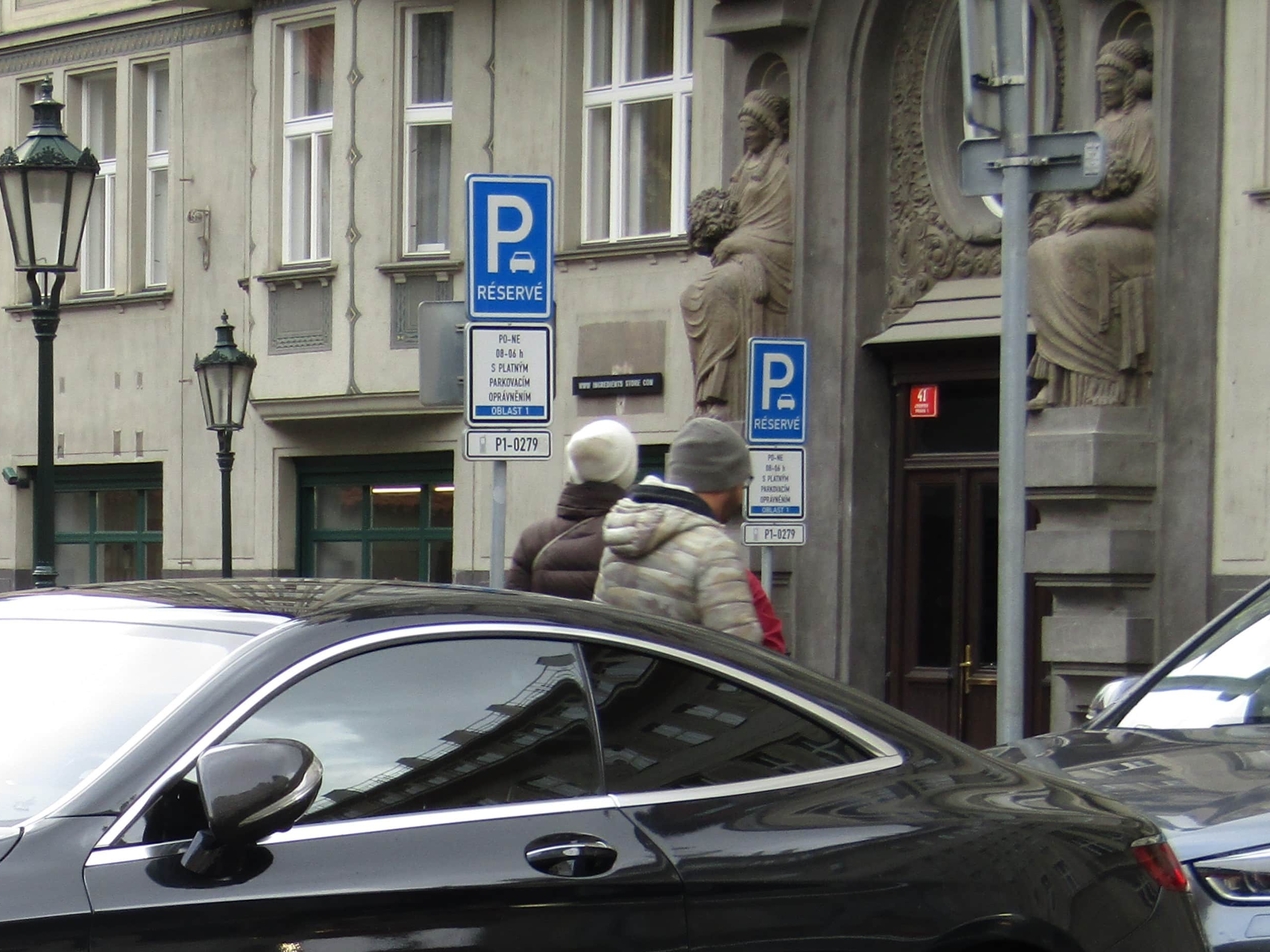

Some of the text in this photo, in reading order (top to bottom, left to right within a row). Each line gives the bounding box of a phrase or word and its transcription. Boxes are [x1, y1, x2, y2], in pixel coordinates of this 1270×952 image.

[487, 194, 533, 273] P
[477, 281, 543, 301] RÉSERVÉ
[498, 334, 521, 344] PO-NE
[495, 348, 524, 358] 08-06 h
[491, 361, 529, 373] S PLATNÝM
[489, 376, 531, 387] PARKOVACÍM
[761, 352, 795, 410] P
[488, 390, 532, 402] OPRÁVNĚNÍM
[491, 406, 530, 416] OBLAST 1
[754, 416, 801, 430] RÉSERVÉ
[495, 437, 539, 452] P1-0279
[764, 528, 796, 540] P1-0279
